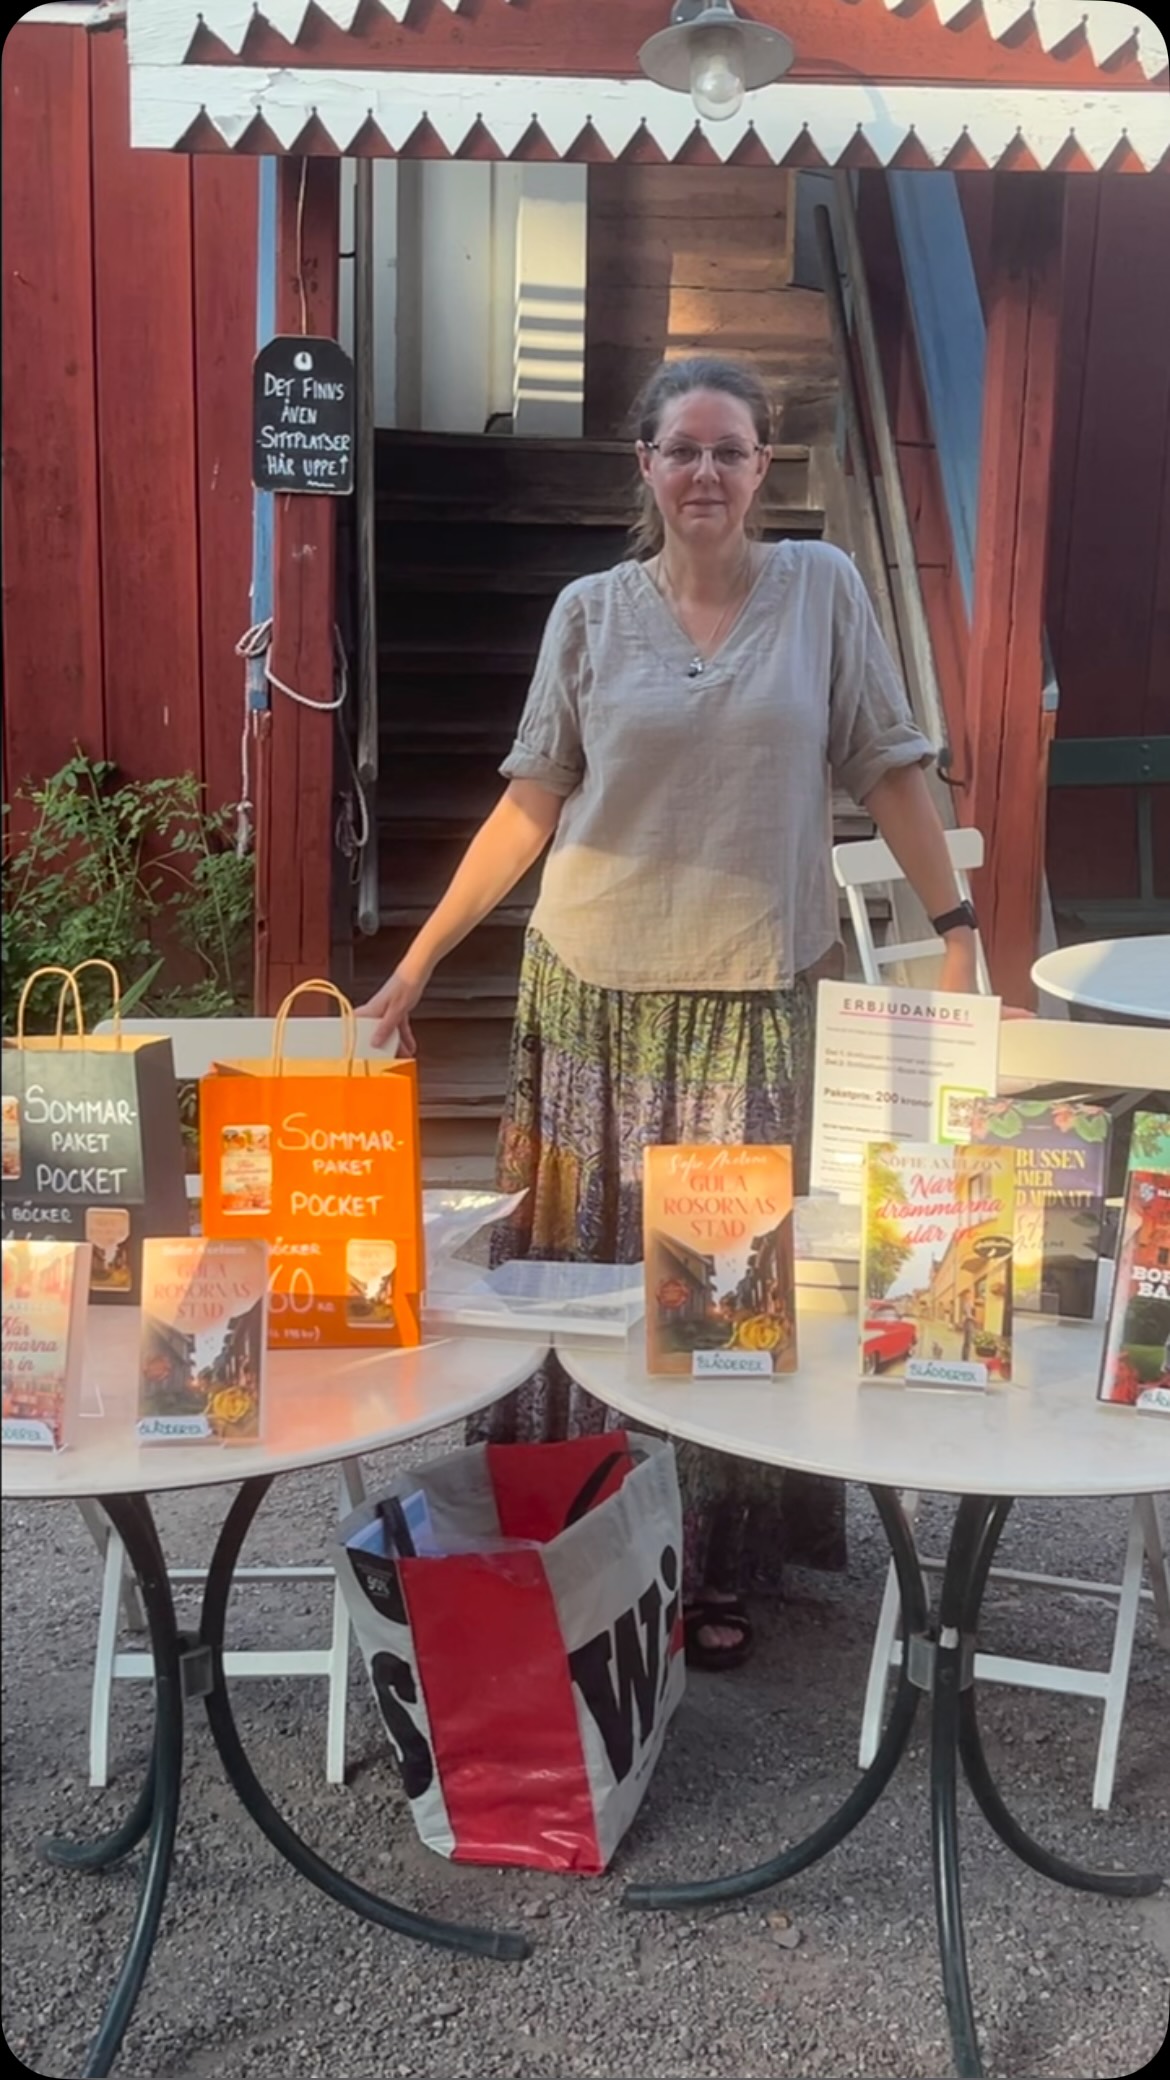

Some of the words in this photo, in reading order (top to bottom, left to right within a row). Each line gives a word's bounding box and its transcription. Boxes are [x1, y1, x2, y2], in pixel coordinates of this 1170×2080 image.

[264, 372, 295, 397] DET
[303, 377, 345, 401] FINNS
[303, 458, 338, 476] UPPE
[843, 998, 971, 1021] ERBJUDANDE!
[24, 1084, 138, 1126] SOMMAR-
[875, 1090, 899, 1105] 200
[277, 1112, 404, 1152] SOMMAR-
[51, 1131, 110, 1153] PAKET
[312, 1158, 374, 1176] PAKET
[1016, 1148, 1086, 1169] BUSSEN
[36, 1164, 128, 1194] POCKET
[689, 1175, 748, 1192] GULA
[290, 1190, 384, 1217] POCKET
[664, 1197, 776, 1215] ROSORNAS
[690, 1219, 746, 1237] STAD
[154, 1282, 250, 1298] ROSORNAS
[178, 1302, 224, 1319] STAD
